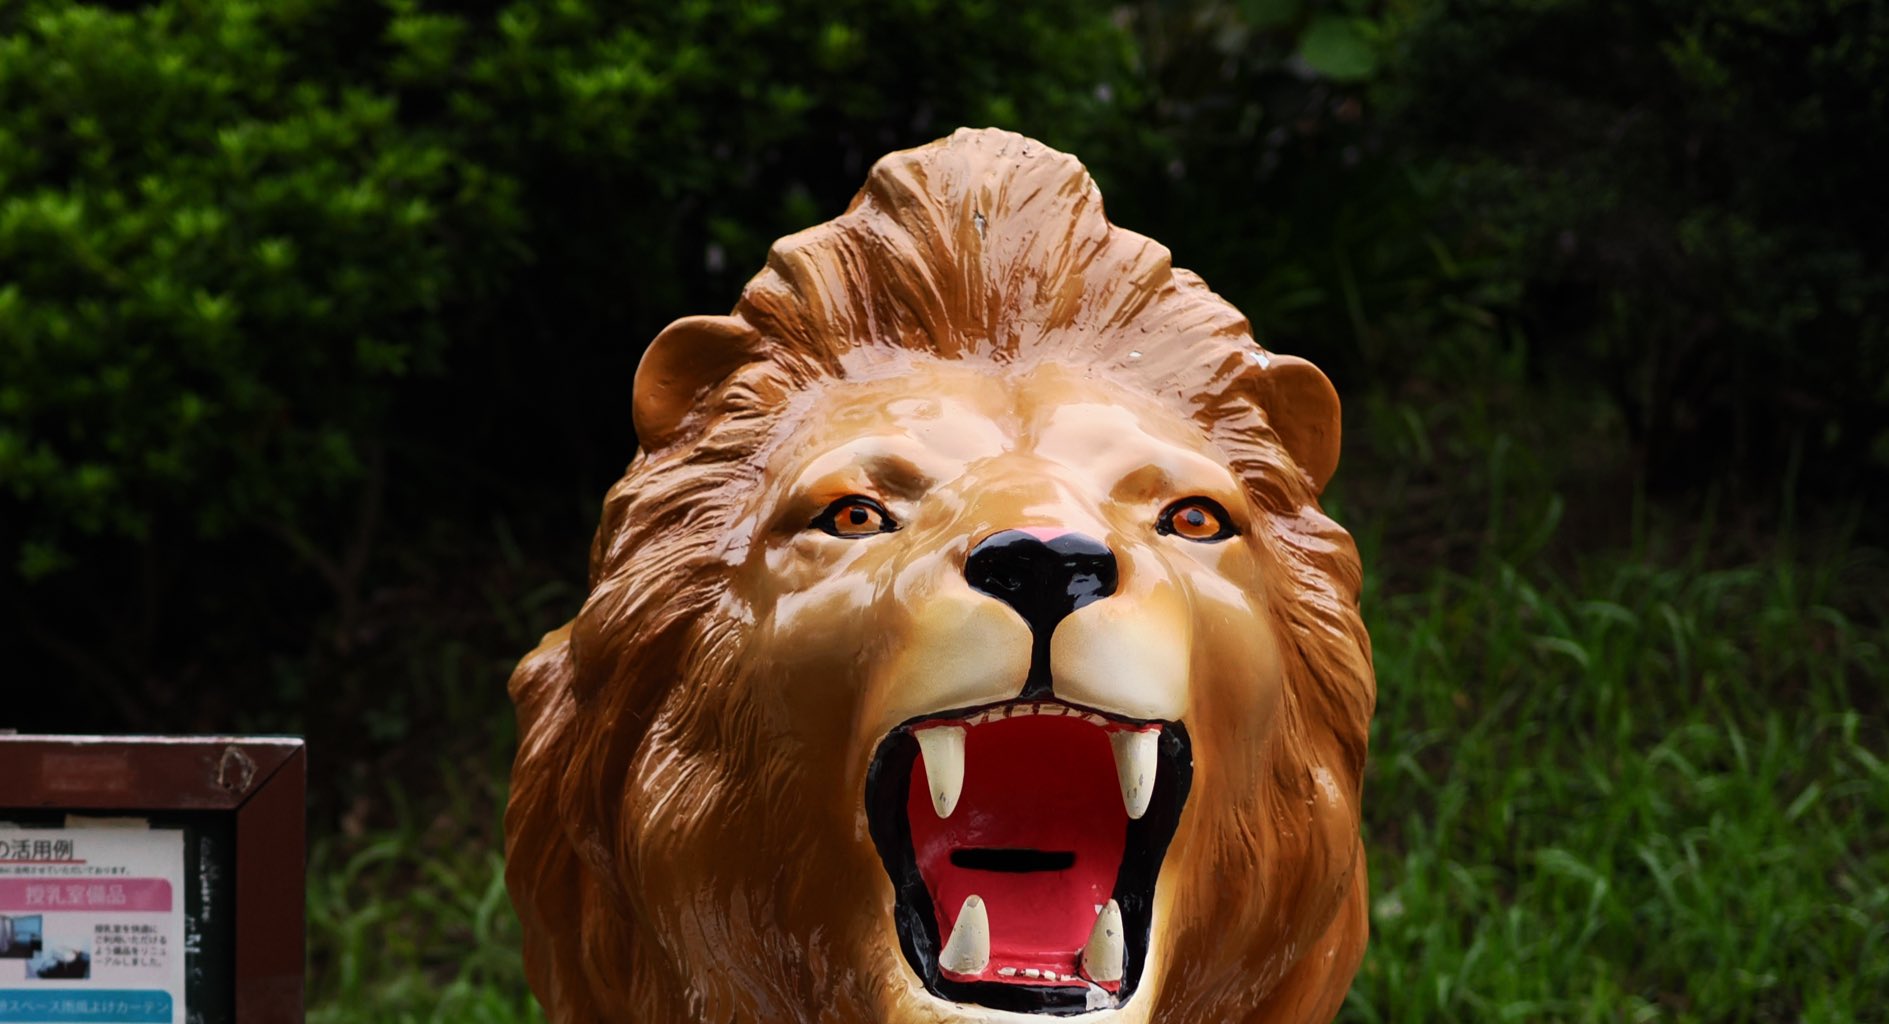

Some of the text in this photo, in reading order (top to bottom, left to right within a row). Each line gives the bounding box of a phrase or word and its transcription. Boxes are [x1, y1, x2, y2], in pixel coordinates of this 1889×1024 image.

[27, 885, 126, 905] 授乳室備品
